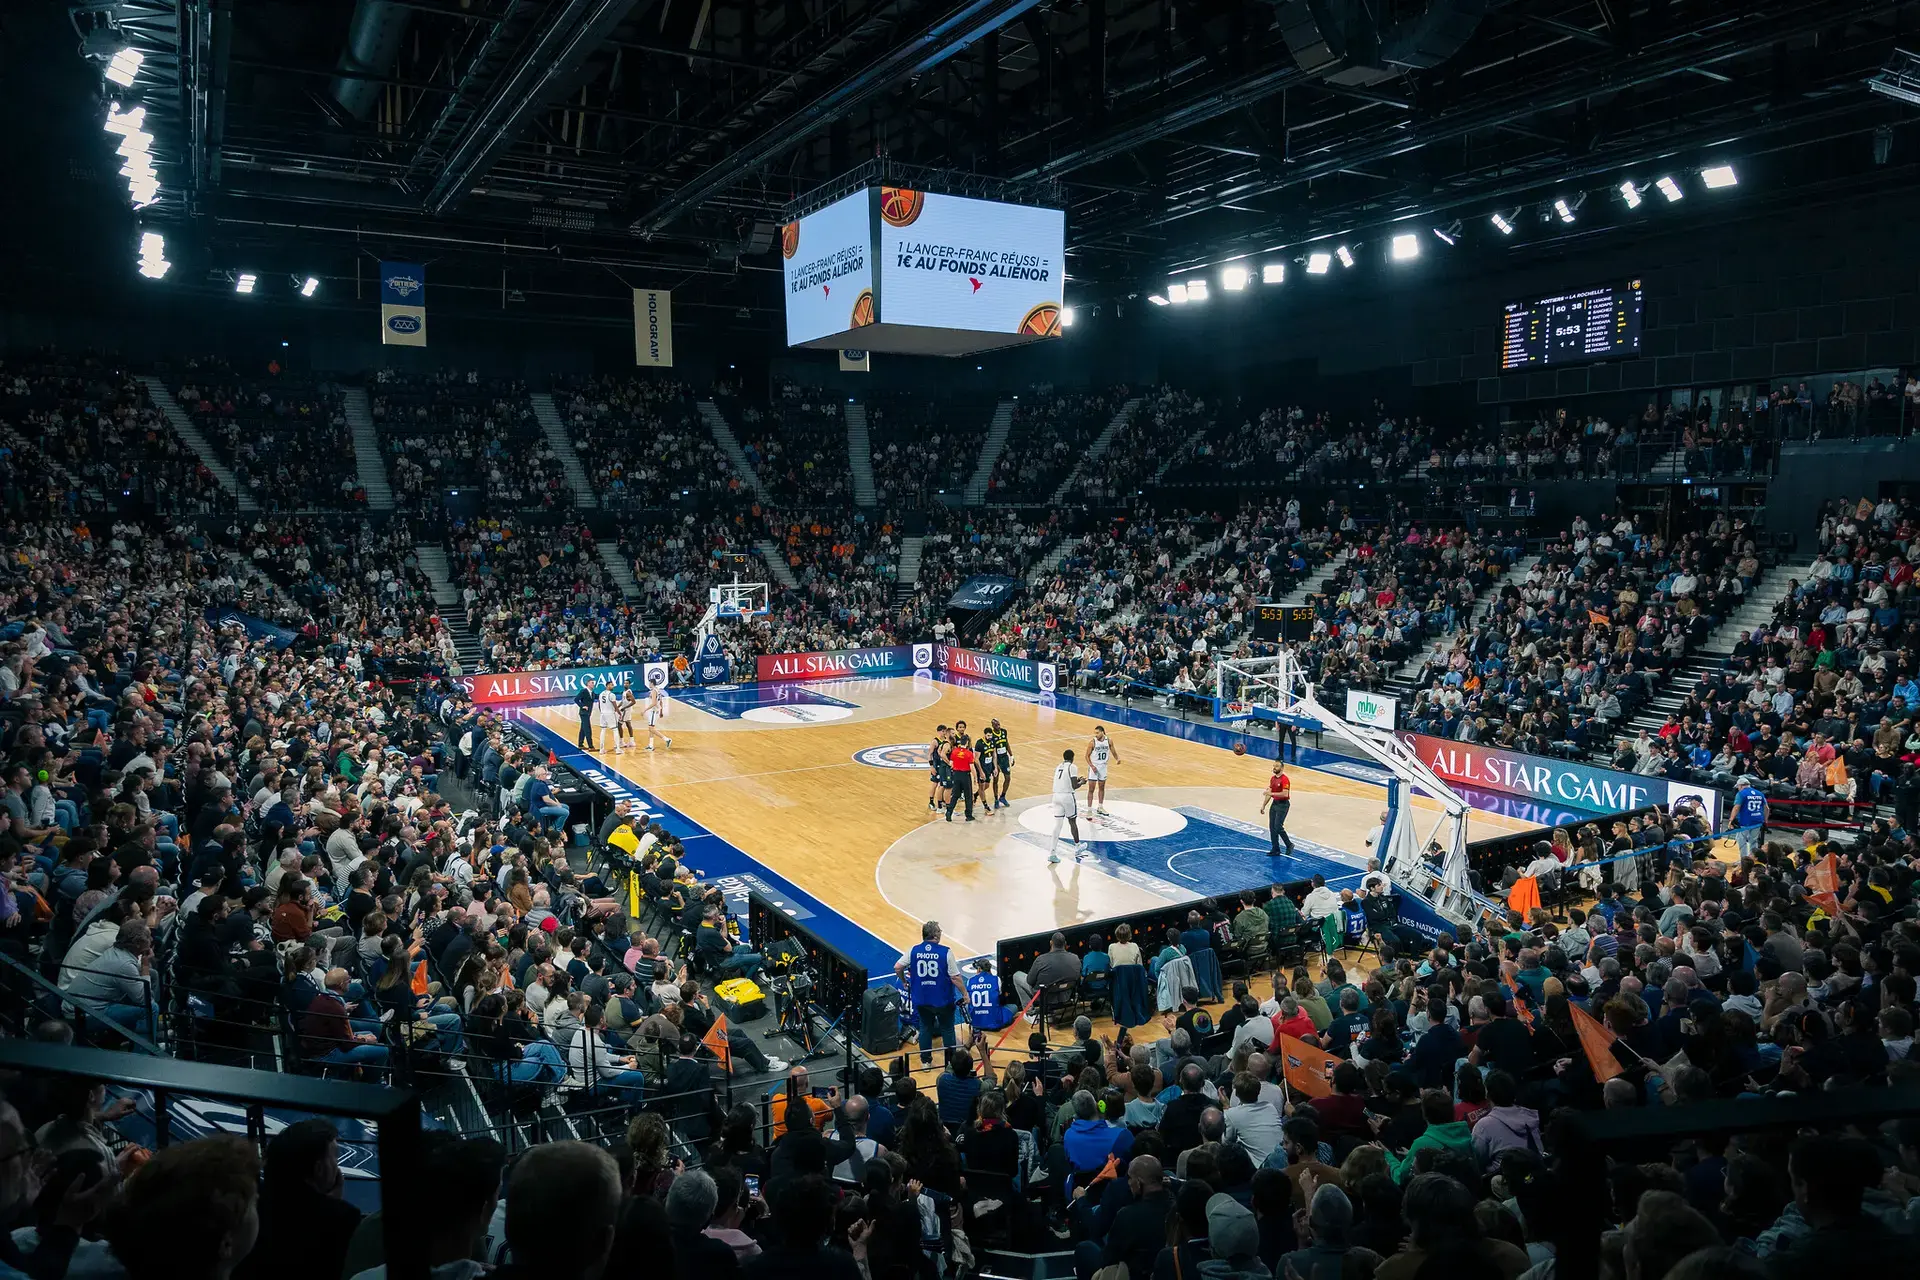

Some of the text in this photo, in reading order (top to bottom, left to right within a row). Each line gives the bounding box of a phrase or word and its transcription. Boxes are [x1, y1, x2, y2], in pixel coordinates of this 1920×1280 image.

[794, 254, 836, 280] LANCER-FRANC
[836, 245, 858, 263] RÉUSSI
[898, 241, 904, 253] 1
[906, 242, 998, 262] LANCER-FRANC
[1000, 251, 1040, 267] RÉUSSI
[897, 254, 913, 268] 1€
[915, 256, 937, 270] AU
[938, 258, 987, 276] FONDS
[798, 276, 808, 291] AU
[808, 268, 831, 288] FONDS
[1576, 289, 1604, 298] ROCHELLE
[1555, 325, 1581, 336] 5:53
[1261, 608, 1283, 621] 5:53
[1292, 608, 1313, 621] 5:53
[771, 655, 804, 675] ALL
[806, 654, 847, 672] STAR
[848, 651, 894, 669] GAME
[953, 652, 974, 671] ALL
[973, 655, 999, 676] STAR
[1000, 661, 1032, 683] GAME
[487, 678, 527, 697] ALL
[529, 674, 577, 694] STAR
[580, 670, 635, 689] GAME
[1357, 696, 1377, 714] mhv
[1097, 752, 1107, 761] 10
[1058, 769, 1064, 780] 7
[1431, 747, 1480, 780] ALL
[1483, 757, 1552, 796] STAR
[1556, 772, 1648, 811] GAME
[1747, 800, 1762, 812] 07
[1401, 916, 1443, 936] DES NATION
[916, 952, 940, 960] PHOTO
[916, 960, 939, 978] 08
[971, 991, 993, 1007] 01
